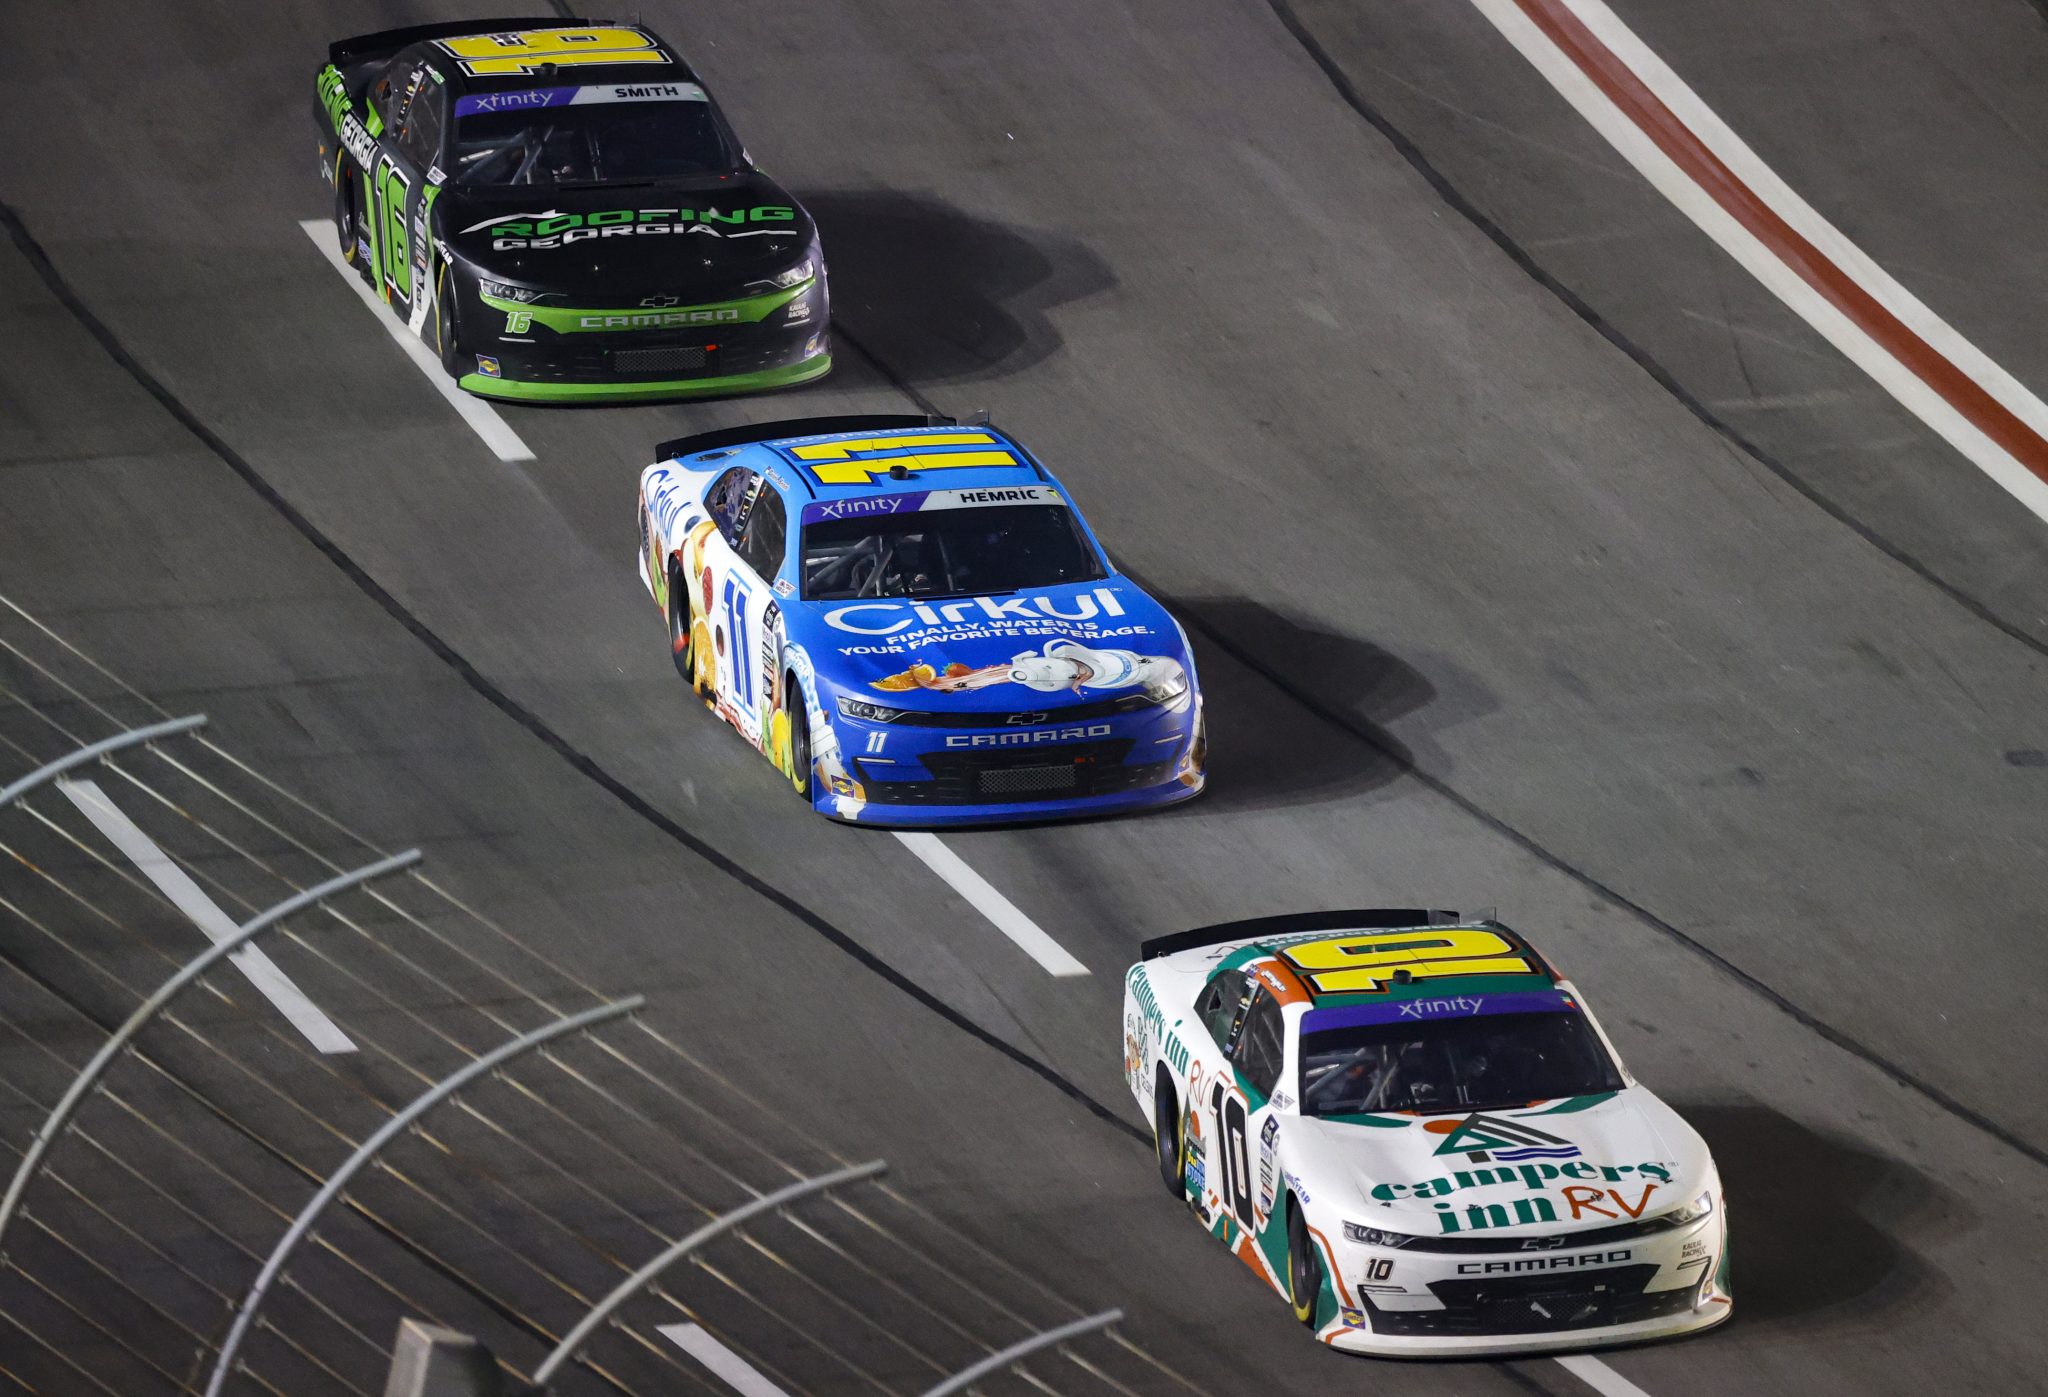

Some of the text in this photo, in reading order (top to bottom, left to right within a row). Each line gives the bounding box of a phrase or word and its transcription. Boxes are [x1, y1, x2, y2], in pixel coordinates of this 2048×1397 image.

[476, 90, 553, 111] xfinity
[615, 85, 679, 98] SMITH
[340, 113, 379, 175] GEORGIA
[376, 153, 411, 304] 16
[491, 206, 794, 237] ROOFING
[492, 223, 722, 251] GEORGIA
[505, 311, 533, 334] 16
[580, 309, 738, 329] CAMARO
[786, 432, 1022, 485] 11
[646, 469, 692, 547] Cirkul
[821, 497, 902, 519] xfinity
[960, 489, 1040, 504] HEMRIC
[824, 588, 1125, 635] Cirkul
[723, 569, 755, 719] 11
[837, 625, 1155, 656] YOUR FAVORITE BEVERAGE.
[886, 619, 1099, 645] FINALLY, WATER IS
[866, 731, 888, 752] 11
[946, 725, 1111, 747] CAMARO
[1280, 930, 1535, 993] 10
[1399, 995, 1483, 1019] xfinity
[1164, 1020, 1190, 1078] inn
[1190, 1060, 1211, 1107] RV
[1210, 1074, 1256, 1236] 10
[1371, 1161, 1672, 1201] campers
[1432, 1184, 1659, 1235] inn RV
[1365, 1258, 1394, 1281] 10
[1458, 1250, 1631, 1274] CAMARO
